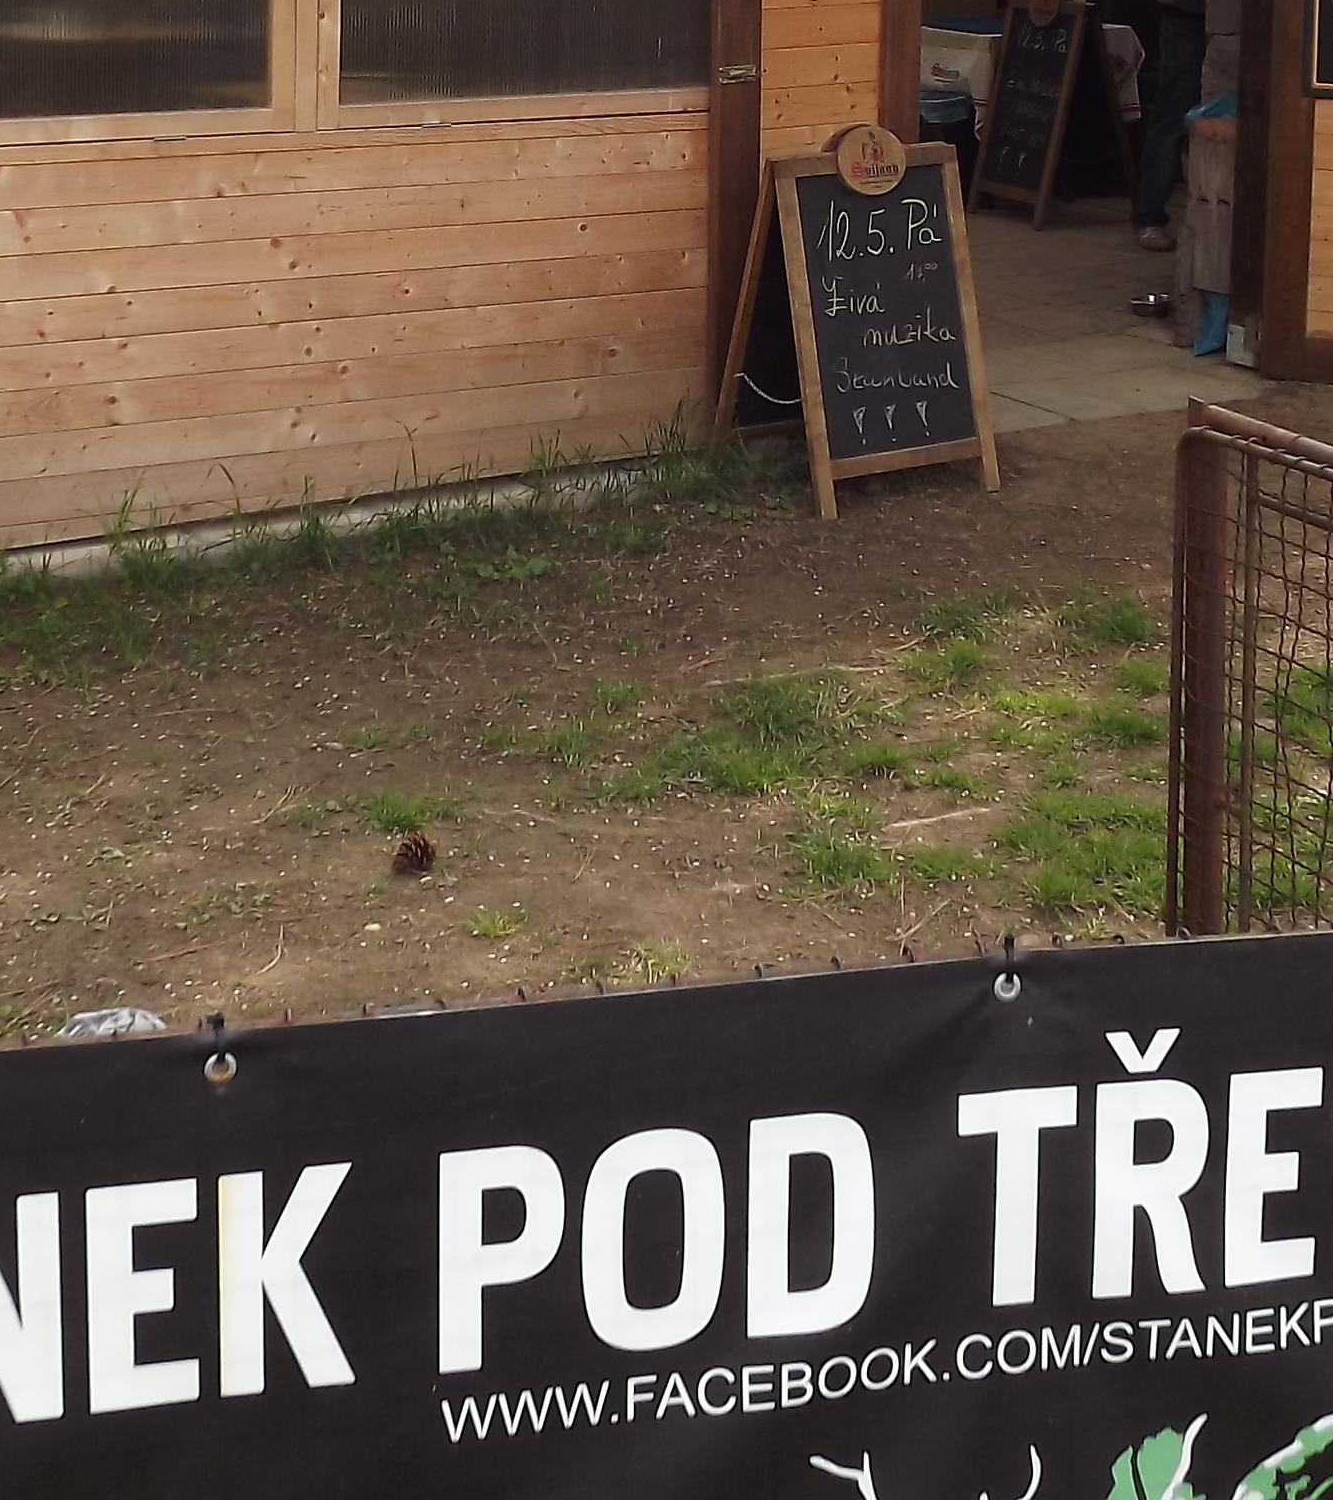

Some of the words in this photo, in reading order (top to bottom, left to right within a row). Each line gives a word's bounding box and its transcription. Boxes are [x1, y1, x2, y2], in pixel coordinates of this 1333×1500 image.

[817, 200, 895, 262] 12.5.
[901, 198, 943, 250] Pá
[821, 276, 885, 317] Živá
[863, 306, 956, 348] muzika
[436, 1109, 874, 1376] POD
